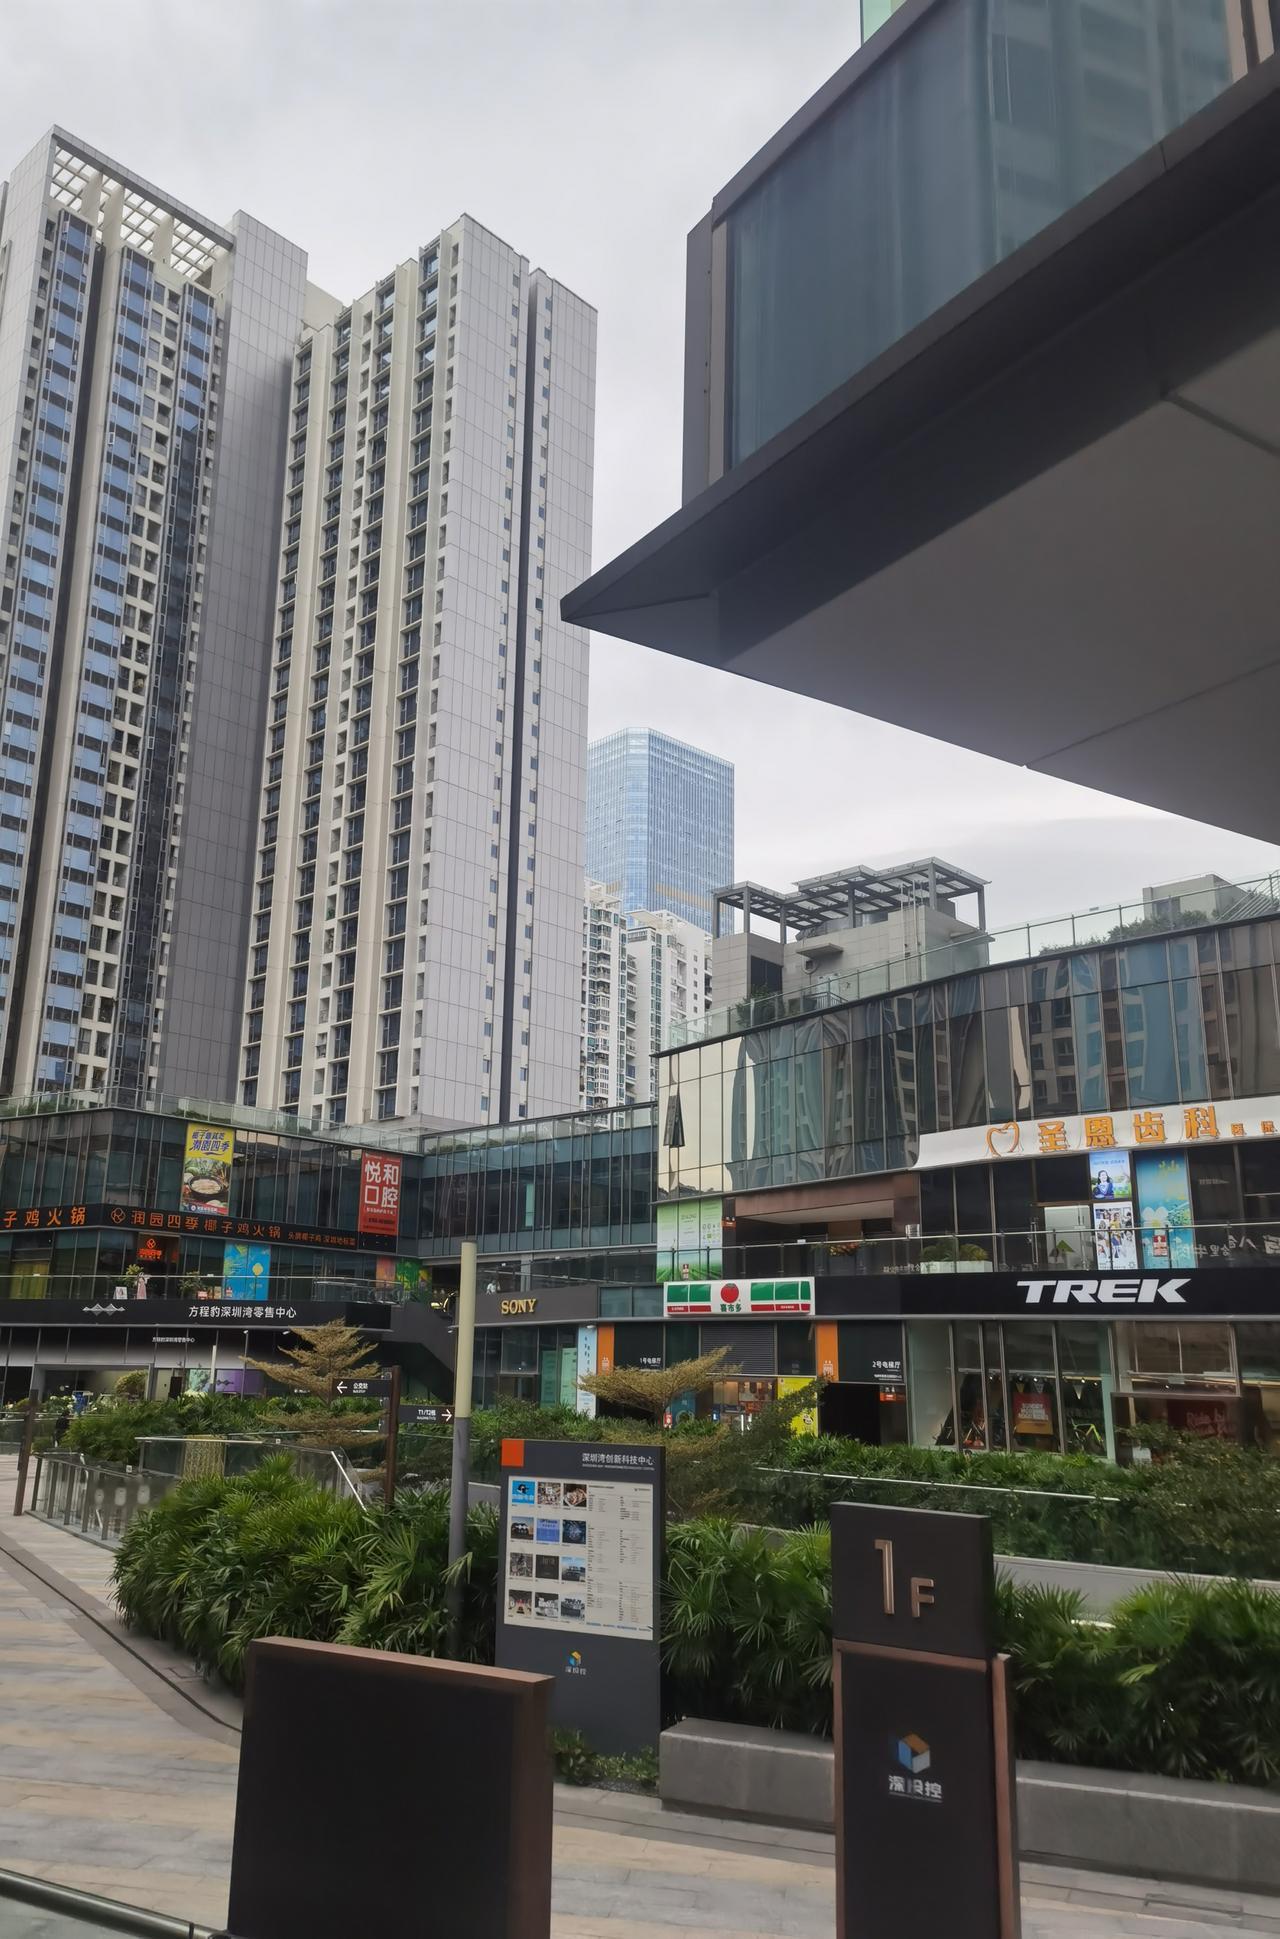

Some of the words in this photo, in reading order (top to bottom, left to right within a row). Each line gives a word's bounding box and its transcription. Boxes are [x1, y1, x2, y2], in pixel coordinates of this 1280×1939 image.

[1037, 1105, 1219, 1152] 圣恩齿科
[364, 1160, 400, 1185] 悦和
[364, 1184, 398, 1208] 口腔
[131, 1210, 282, 1238] 润园四季椰子鸡火锅
[1017, 1278, 1192, 1304] TREK
[188, 1306, 297, 1318] 方程豹深圳湾零售中心
[501, 1299, 536, 1315] SONY
[582, 1452, 655, 1466] 深圳湾创新科技中心
